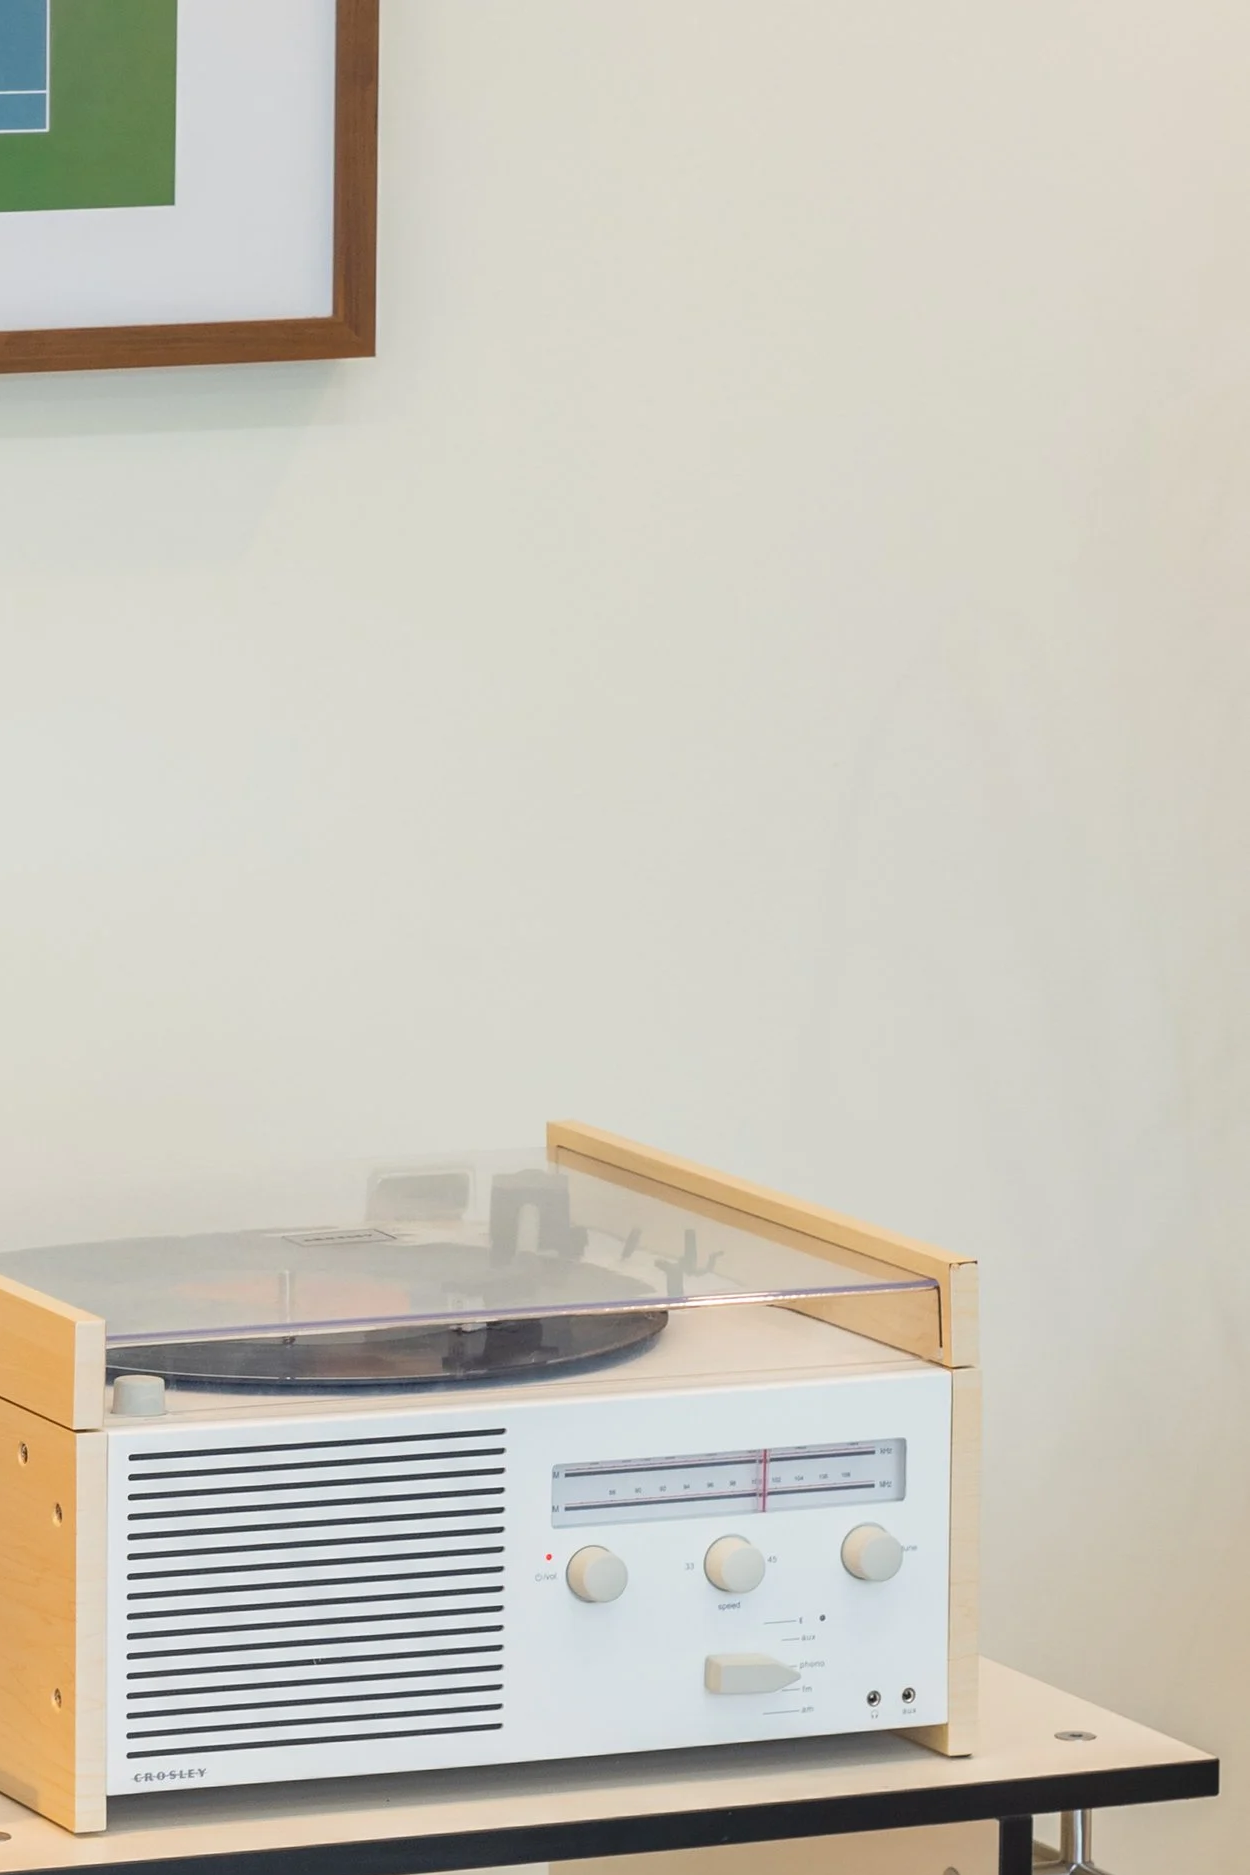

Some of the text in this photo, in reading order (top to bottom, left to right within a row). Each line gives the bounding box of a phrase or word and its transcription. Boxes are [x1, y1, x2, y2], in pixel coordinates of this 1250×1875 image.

[767, 1555, 778, 1563] 45
[685, 1562, 695, 1570] 33
[718, 1601, 741, 1611] speed
[799, 1660, 826, 1669] phono
[133, 1768, 207, 1782] CROSLEY
